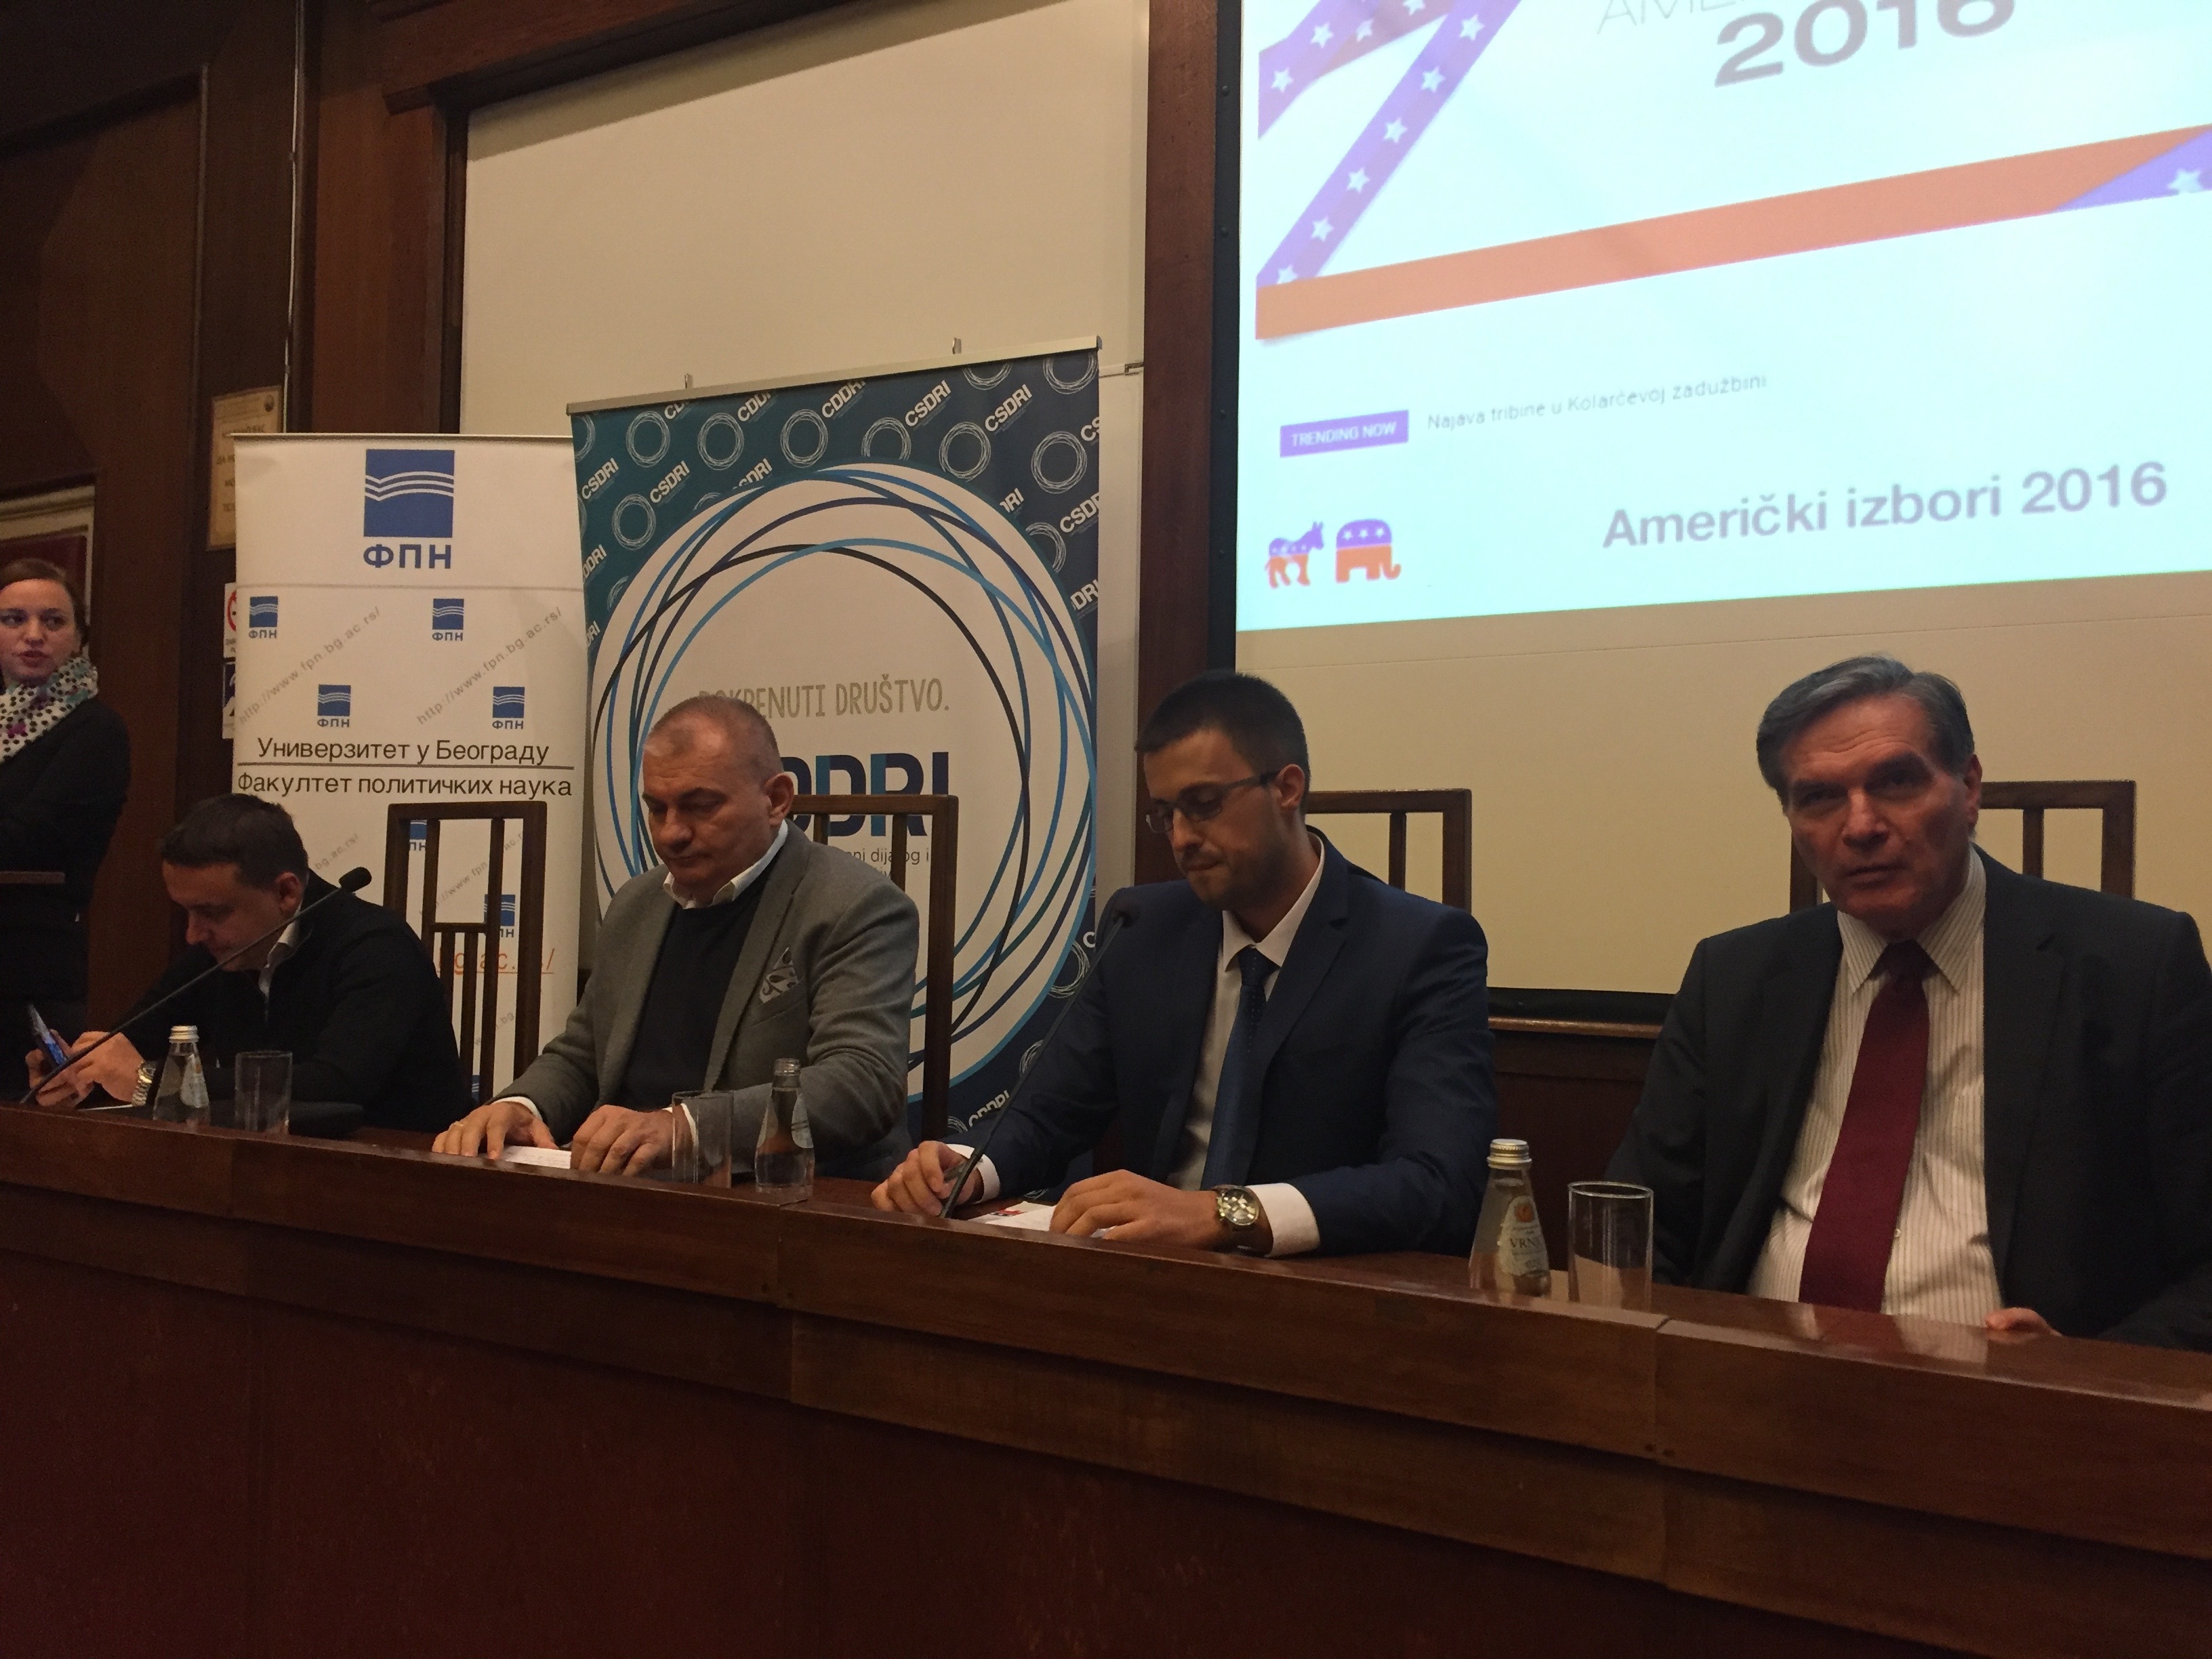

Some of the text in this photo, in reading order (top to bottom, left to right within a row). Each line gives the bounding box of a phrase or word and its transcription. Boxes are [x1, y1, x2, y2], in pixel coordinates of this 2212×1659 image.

[905, 380, 951, 427] CSDRI
[985, 384, 1033, 432] CSDRI
[1427, 413, 1486, 431] Najava
[1491, 403, 1546, 422] tribine
[1551, 402, 1562, 415] u
[1292, 421, 1397, 447] TRENDING NOW
[581, 457, 619, 499] CSDRI
[650, 460, 690, 504] CSDRI
[1603, 461, 2167, 548] Američki izbori 2016
[363, 544, 451, 569] ФПН
[249, 630, 277, 639] ФПН
[432, 632, 464, 641] ФПН
[239, 606, 382, 724] http://www.fpn.bg.ac.rs/
[416, 607, 562, 725] http://www.fpn.bg.ac.rs/
[836, 673, 949, 716] DRUŠTVO.
[317, 718, 350, 728] ФПН
[492, 720, 524, 730] ФПН
[257, 737, 550, 765] Универзитет у Београду
[237, 772, 573, 800] Факултет политичких наука
